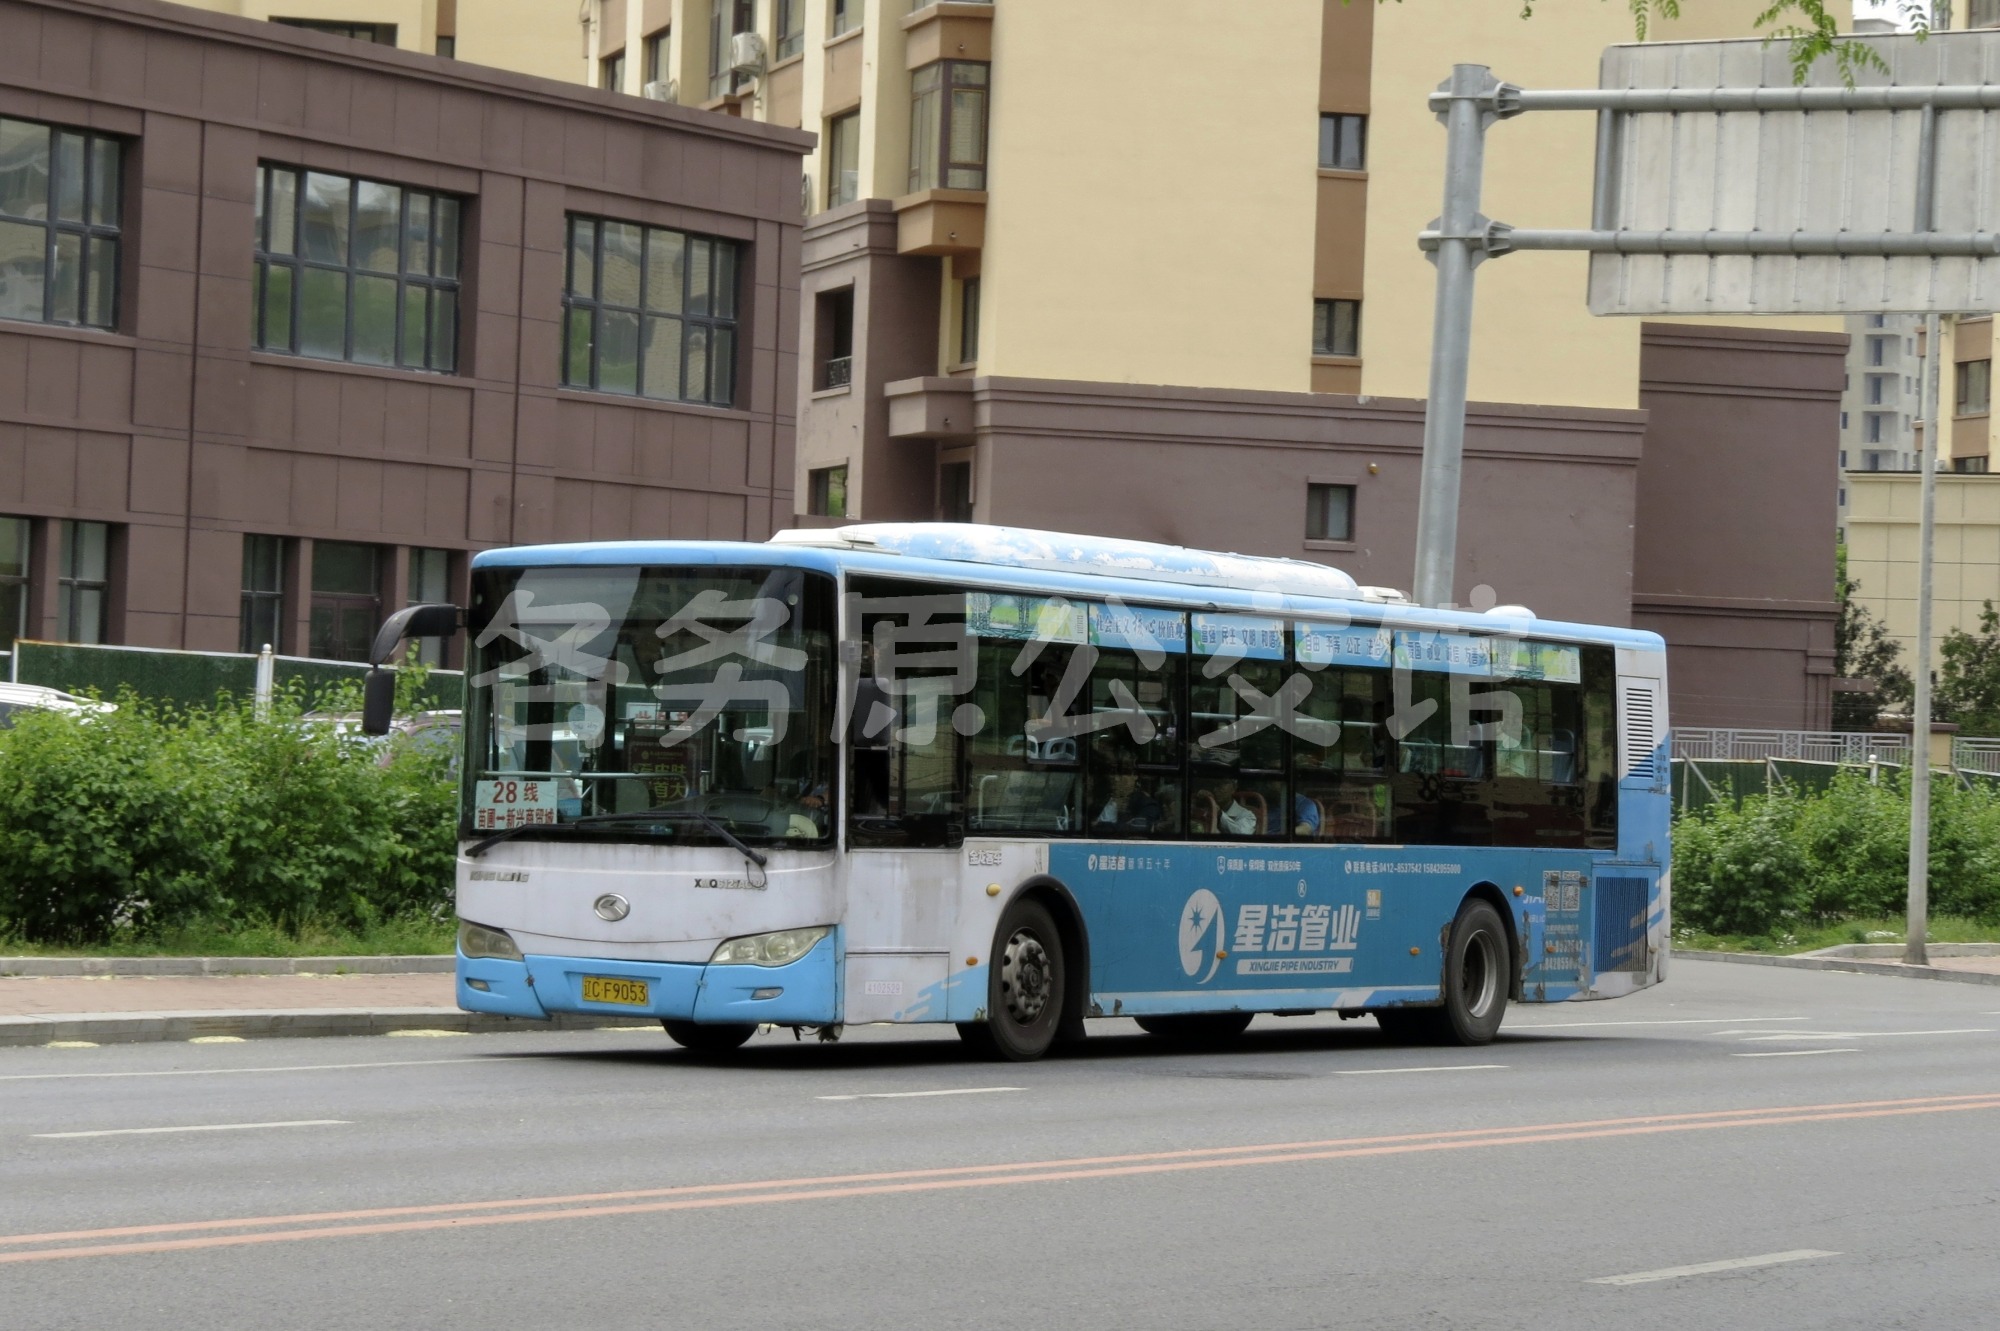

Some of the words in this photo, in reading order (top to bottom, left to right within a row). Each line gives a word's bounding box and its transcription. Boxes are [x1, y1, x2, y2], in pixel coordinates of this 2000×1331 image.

[1096, 612, 1185, 641] 社会主义核心价值观
[1201, 624, 1216, 644] 富强
[1221, 625, 1236, 646] 民主
[1241, 628, 1256, 647] 文明
[1305, 633, 1320, 652] 自由
[1326, 634, 1341, 654] 平等
[1346, 636, 1361, 656] 公正
[493, 781, 517, 803] 28
[523, 782, 538, 802] 线
[969, 849, 1002, 866] 金龙客车
[1232, 904, 1361, 952] 星洁管业
[1249, 961, 1279, 972] XINGJIE
[1280, 960, 1299, 971] PIPE
[1299, 960, 1340, 971] INDUSTRY
[867, 983, 900, 994] 4102529
